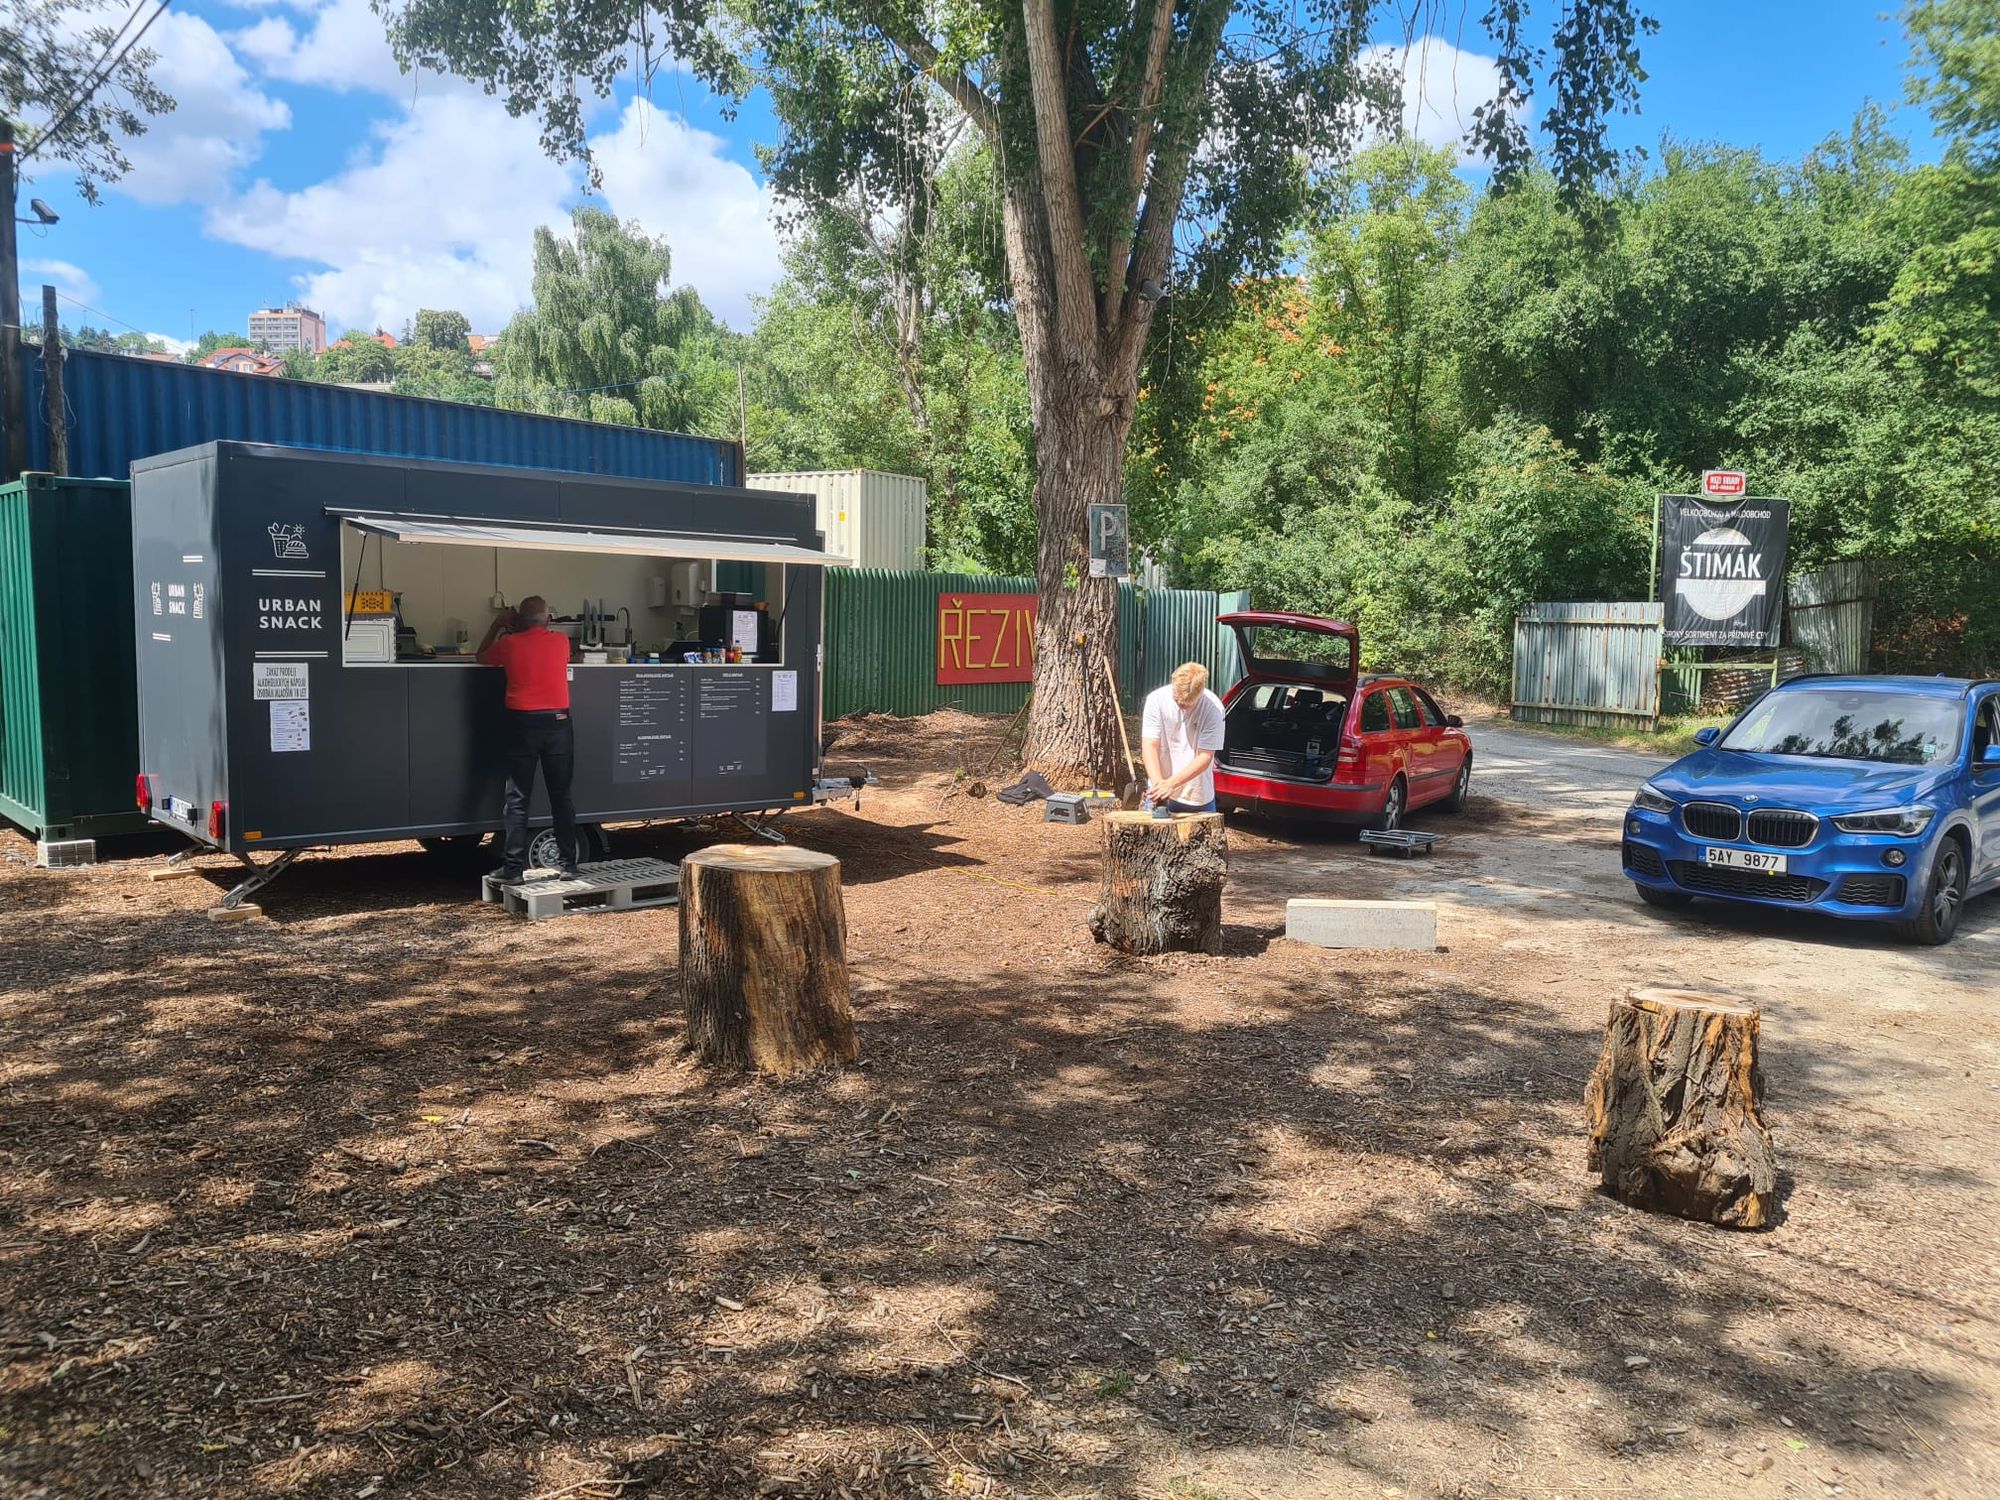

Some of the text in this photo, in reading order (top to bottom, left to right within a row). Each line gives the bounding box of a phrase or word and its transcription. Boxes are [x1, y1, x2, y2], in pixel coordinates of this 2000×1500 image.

[1101, 511, 1117, 551] P
[1680, 545, 1762, 578] ŠTIMÁK
[259, 598, 321, 611] URBAN
[259, 616, 323, 629] SNACK
[1709, 848, 1779, 869] 5AY 9877
